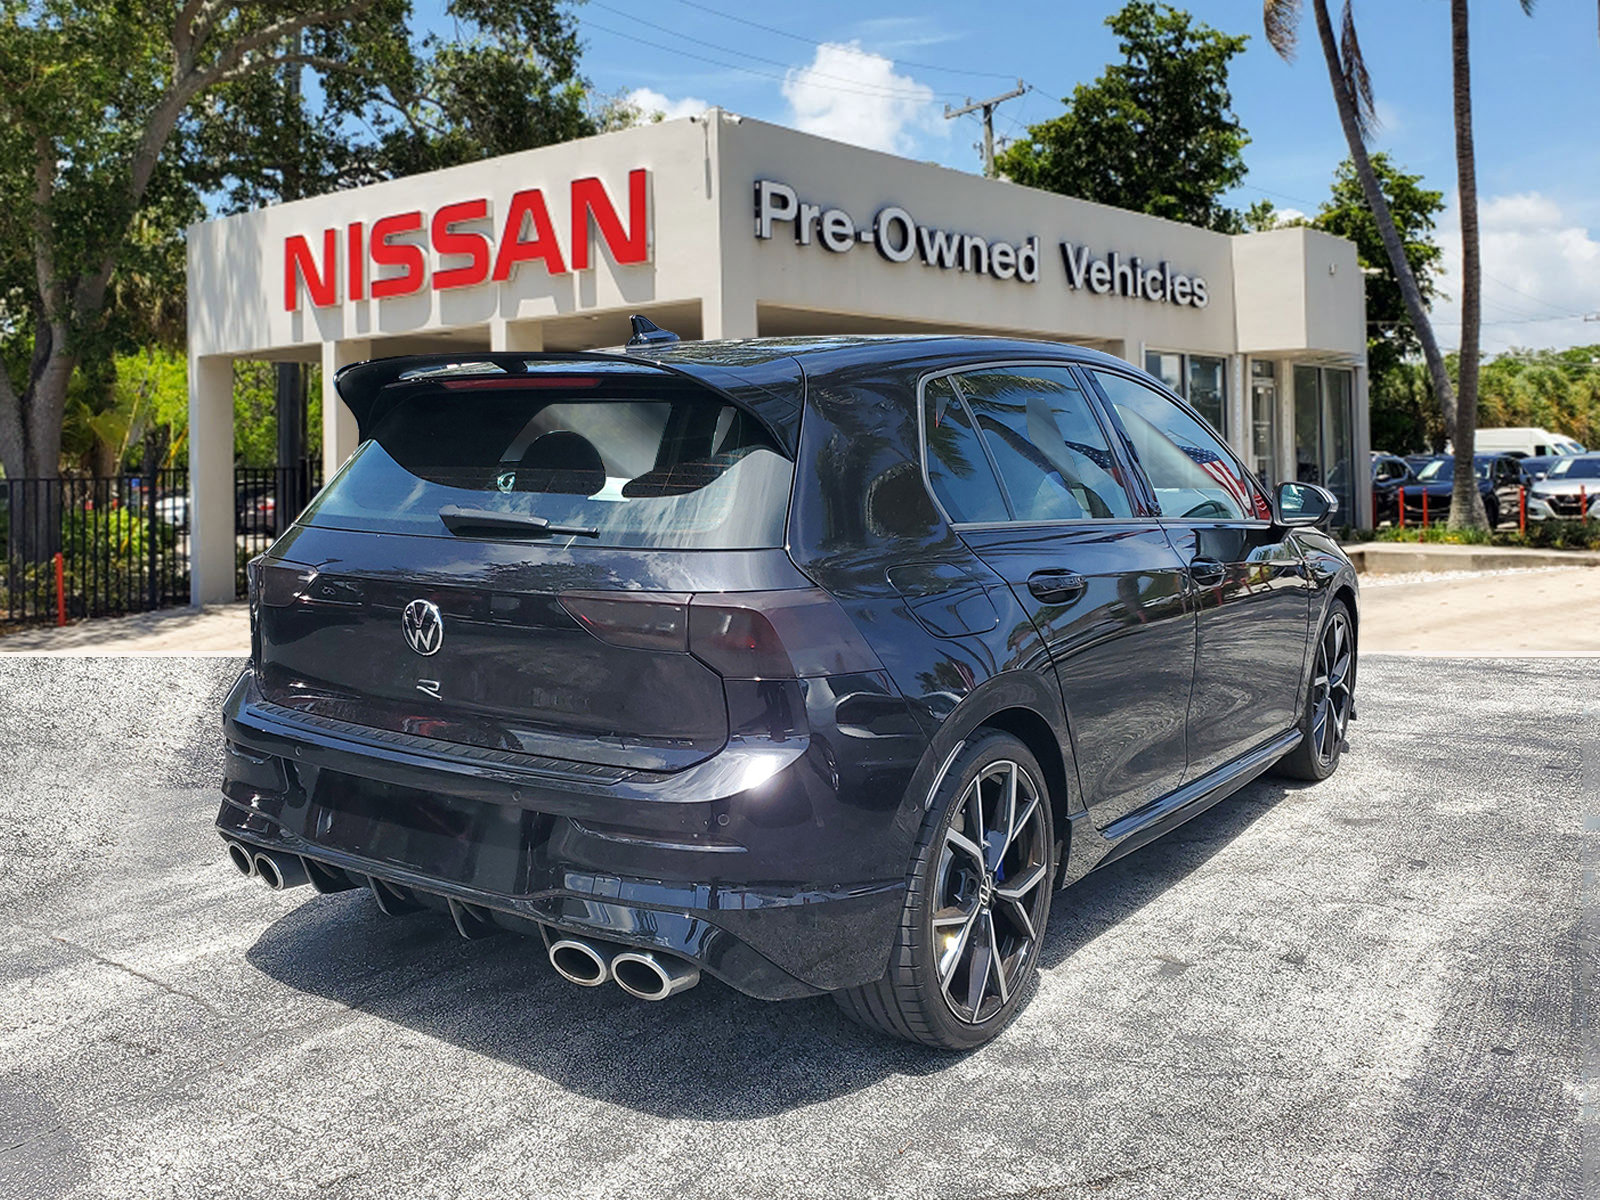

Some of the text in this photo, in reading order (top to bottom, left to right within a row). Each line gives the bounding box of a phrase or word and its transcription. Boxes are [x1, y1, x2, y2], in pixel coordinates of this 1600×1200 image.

[285, 168, 647, 312] NISSAN
[754, 180, 1209, 309] Pre-Owned Vehicles
